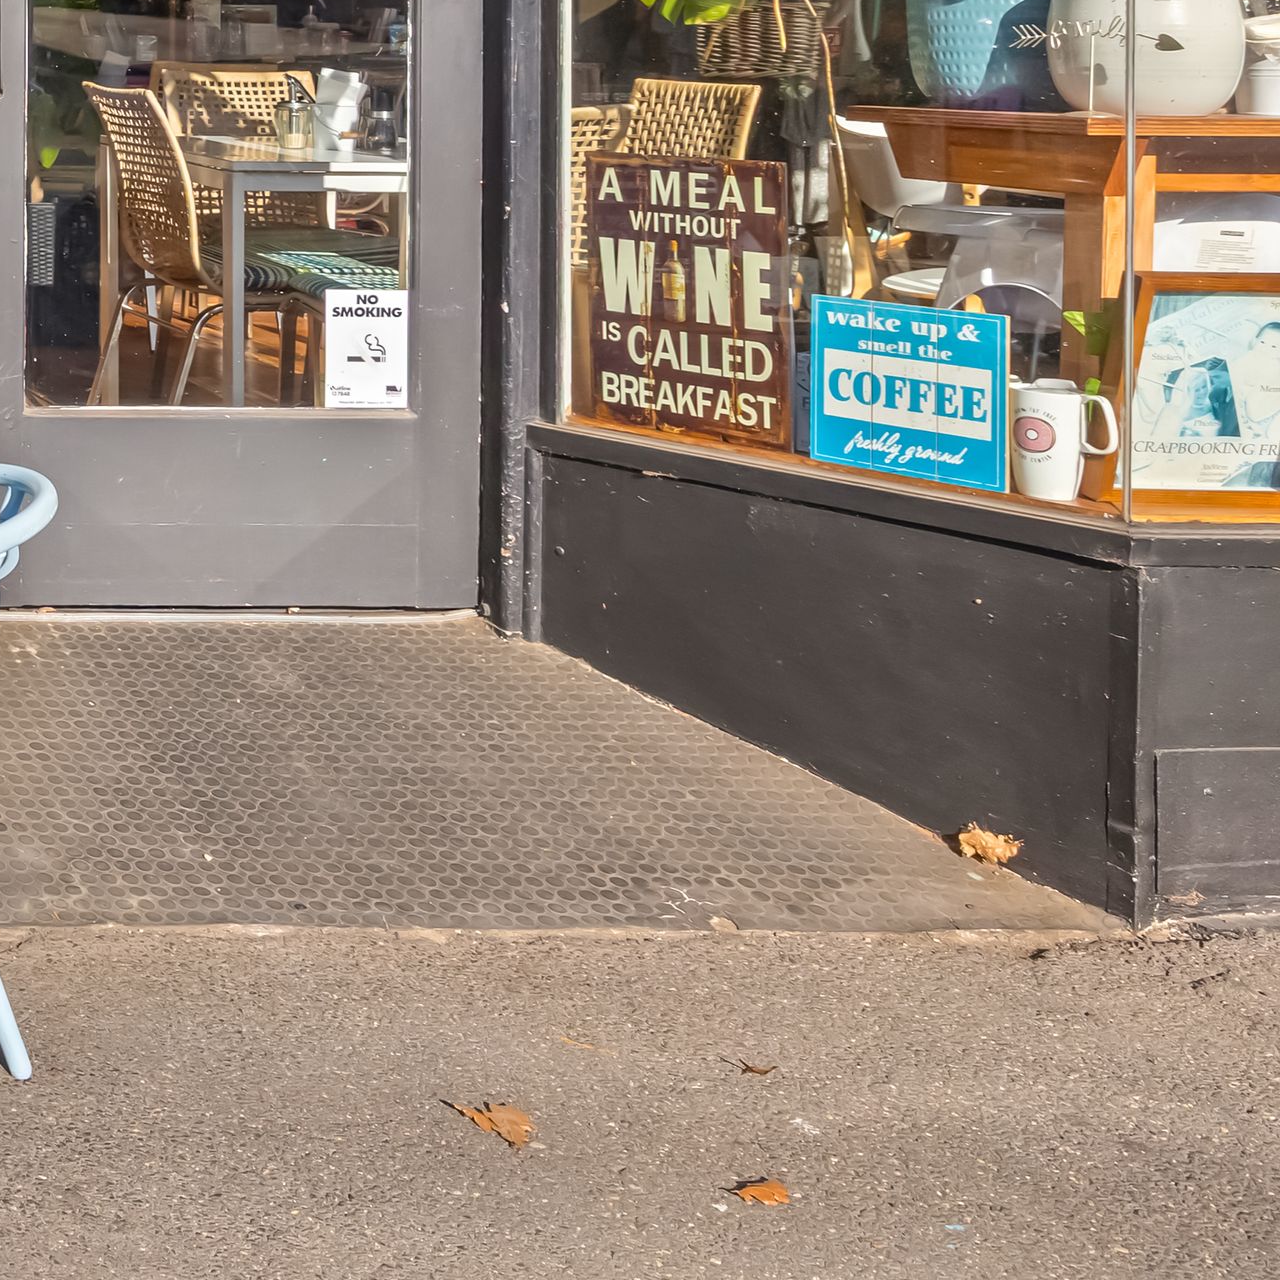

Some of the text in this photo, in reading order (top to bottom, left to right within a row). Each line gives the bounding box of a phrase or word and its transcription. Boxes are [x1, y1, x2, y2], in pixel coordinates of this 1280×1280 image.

[597, 166, 776, 215] A MEAL
[628, 209, 741, 240] WITHOUT
[331, 307, 403, 318] SMOKING
[356, 294, 379, 305] NO
[825, 309, 981, 343] wake up &
[601, 320, 773, 383] IS CALLED
[857, 339, 953, 361] smell the
[601, 370, 777, 430] BREAKFAST
[828, 367, 988, 424] COFFEE
[843, 429, 969, 466] freshly ground
[1130, 440, 1254, 456] CRAPBOOKING
